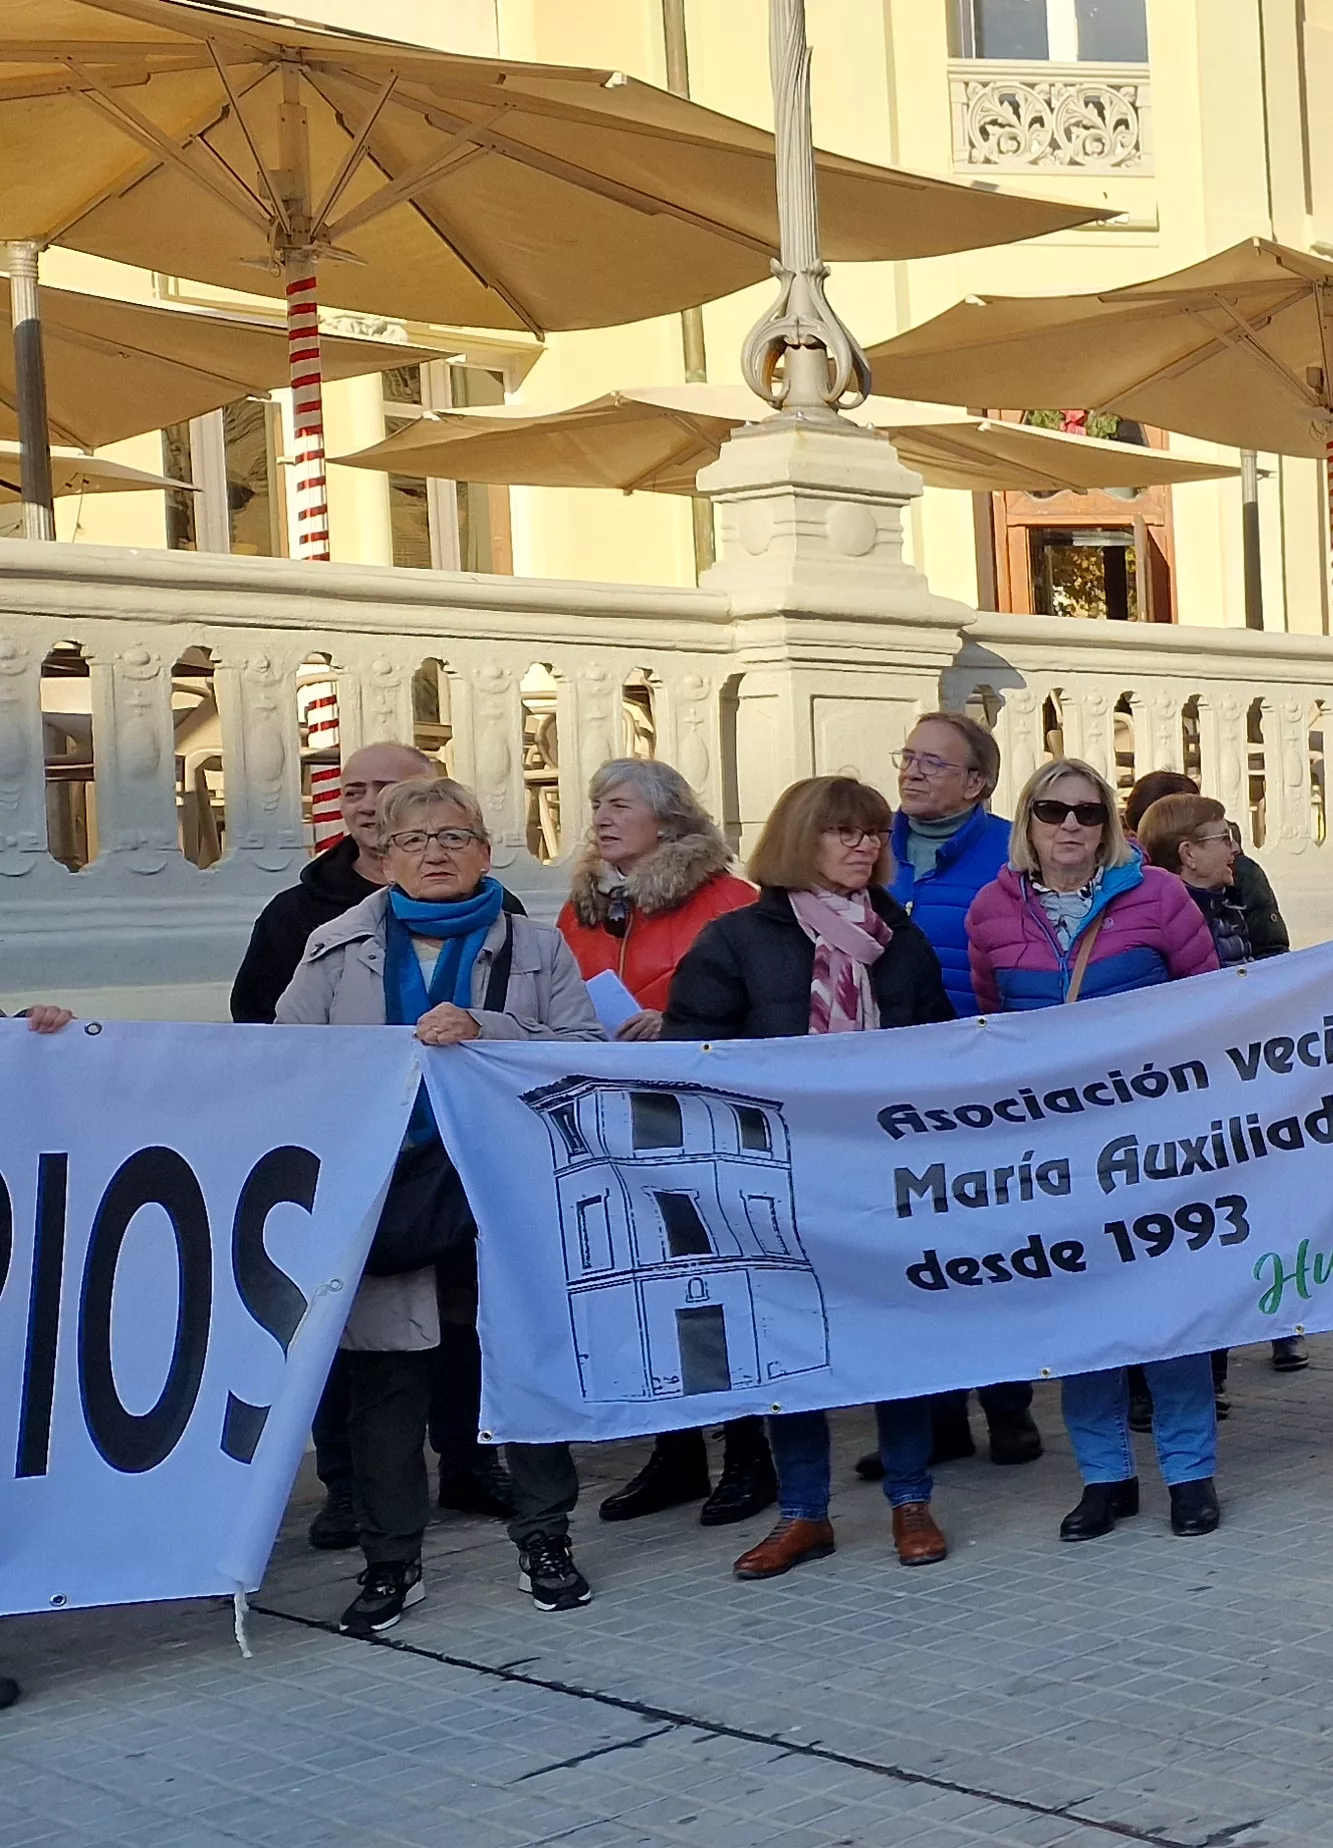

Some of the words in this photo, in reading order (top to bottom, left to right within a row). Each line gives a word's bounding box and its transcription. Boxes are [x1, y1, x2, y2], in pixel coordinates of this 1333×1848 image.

[876, 1058, 1209, 1140] Asociación
[892, 1149, 1072, 1219] María
[905, 1234, 1087, 1293] desde
[1103, 1194, 1251, 1264] 1993
[0, 1144, 322, 1480] IOS
